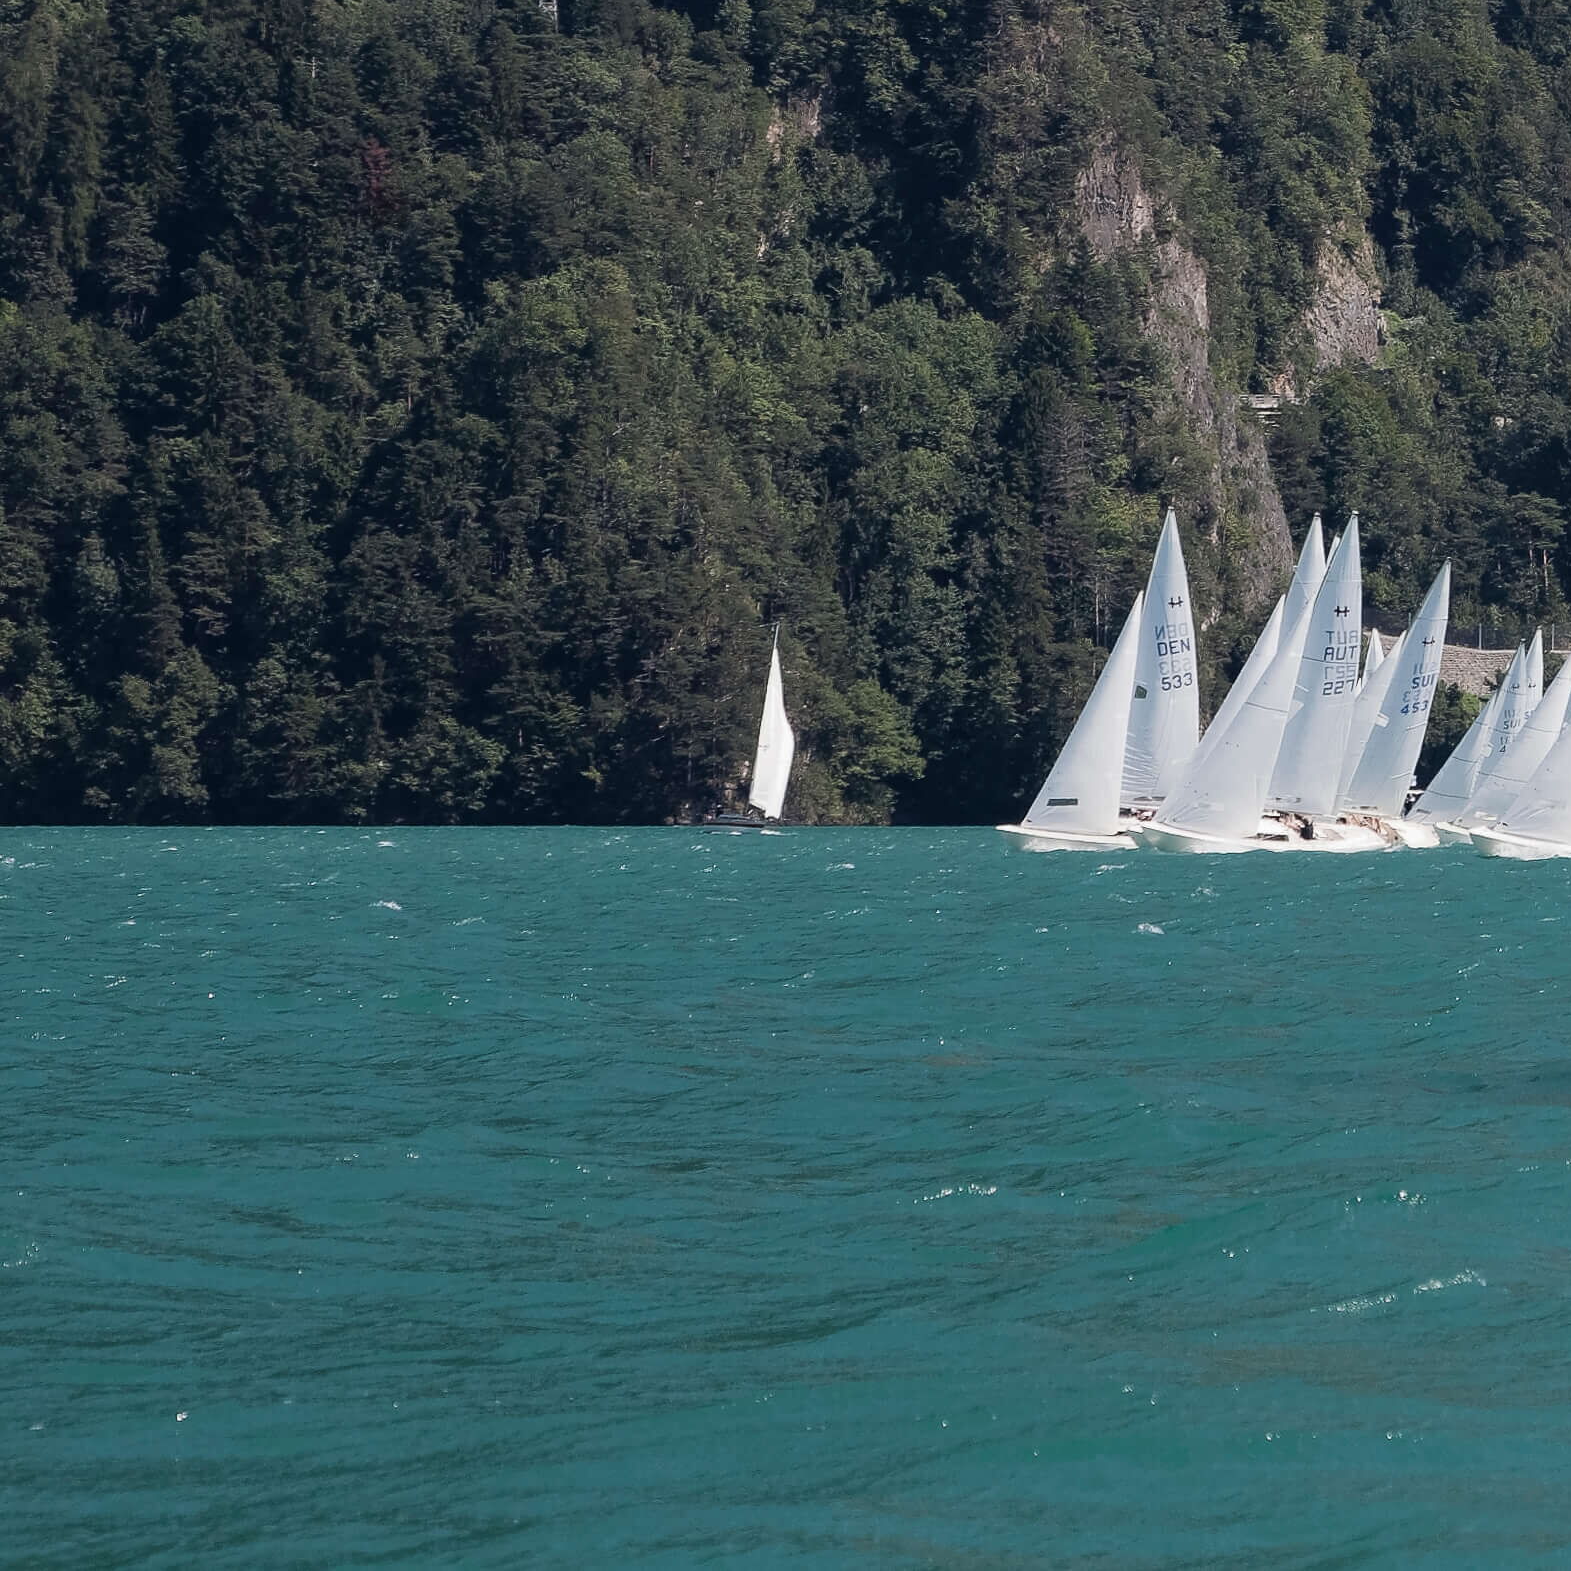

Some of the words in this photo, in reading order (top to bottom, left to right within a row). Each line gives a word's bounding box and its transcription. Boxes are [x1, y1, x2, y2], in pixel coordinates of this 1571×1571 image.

[1157, 638, 1190, 656] DEN
[1324, 645, 1357, 661] AUT
[1161, 672, 1192, 691] 533
[1322, 679, 1354, 695] 227
[1412, 673, 1435, 689] SUI
